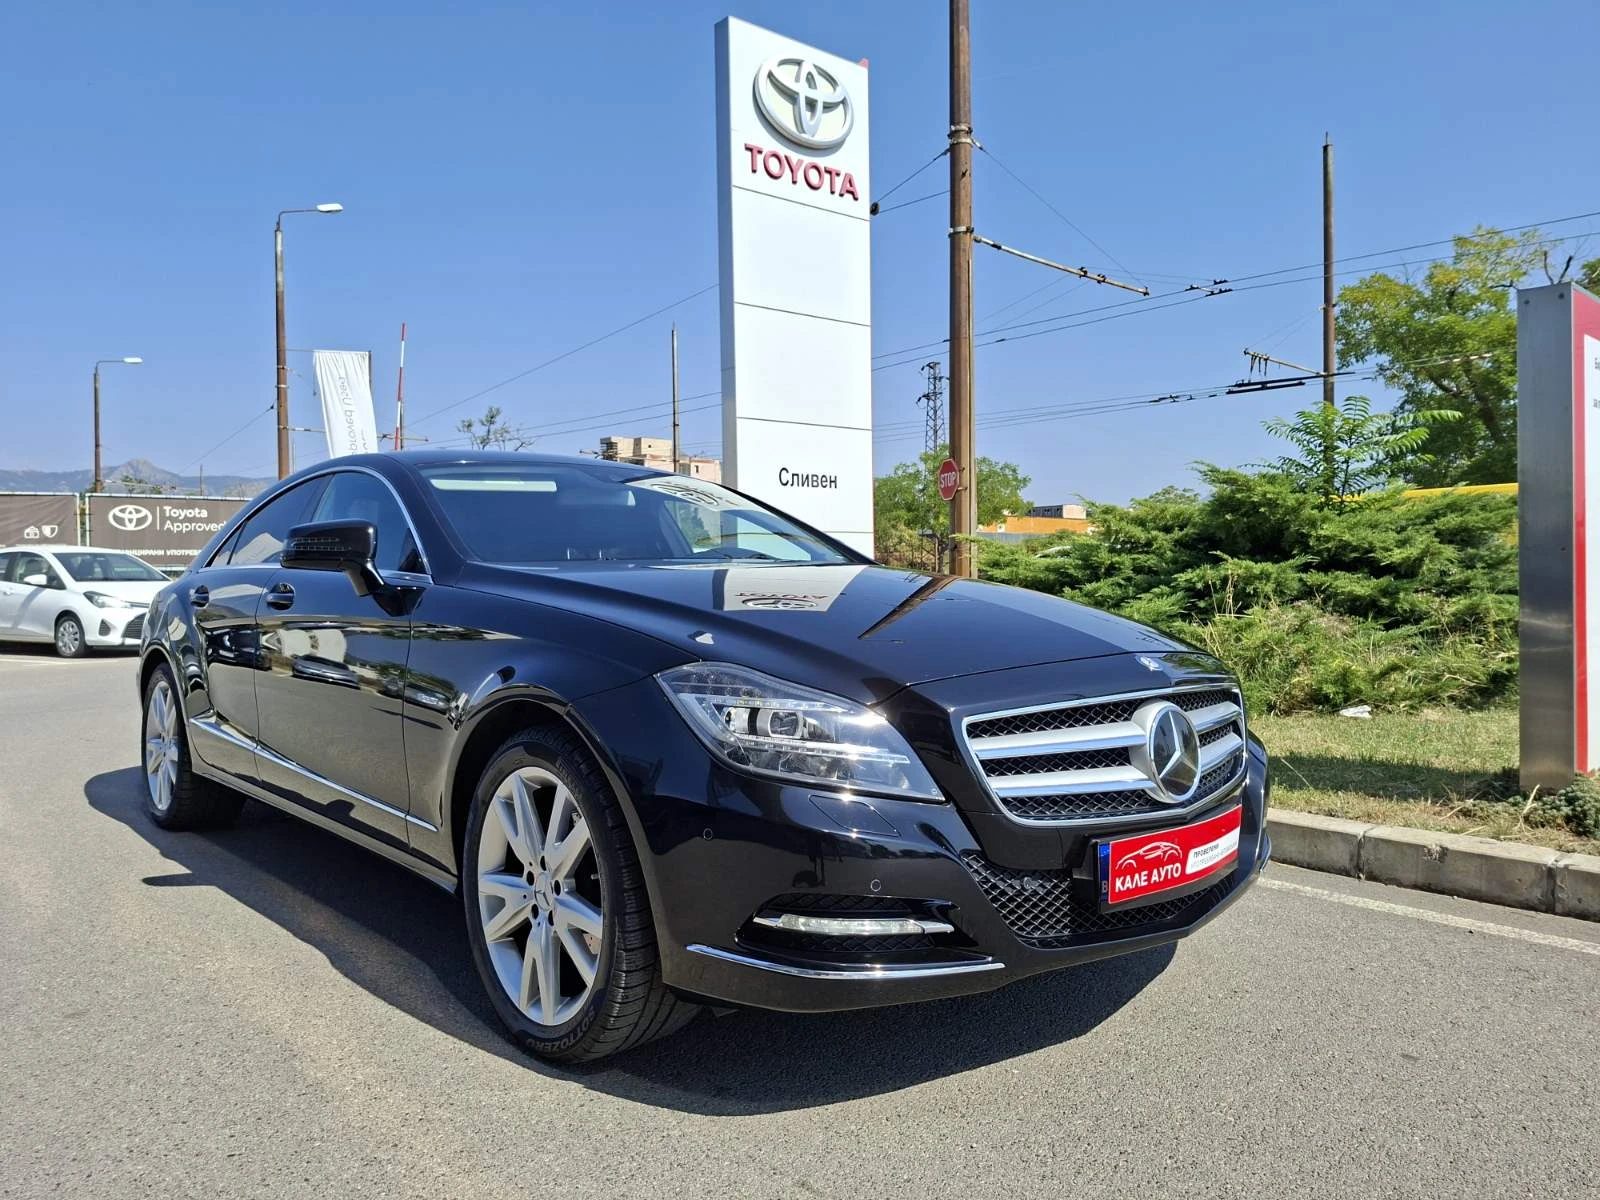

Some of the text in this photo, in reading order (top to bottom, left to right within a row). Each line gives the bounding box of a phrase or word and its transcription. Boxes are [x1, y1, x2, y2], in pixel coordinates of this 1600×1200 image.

[744, 143, 858, 201] TOYOTA
[779, 467, 837, 489] Сливен
[940, 471, 957, 489] STOP
[163, 506, 208, 520] Toyota
[1115, 862, 1182, 893] КАЛЕ АУТО
